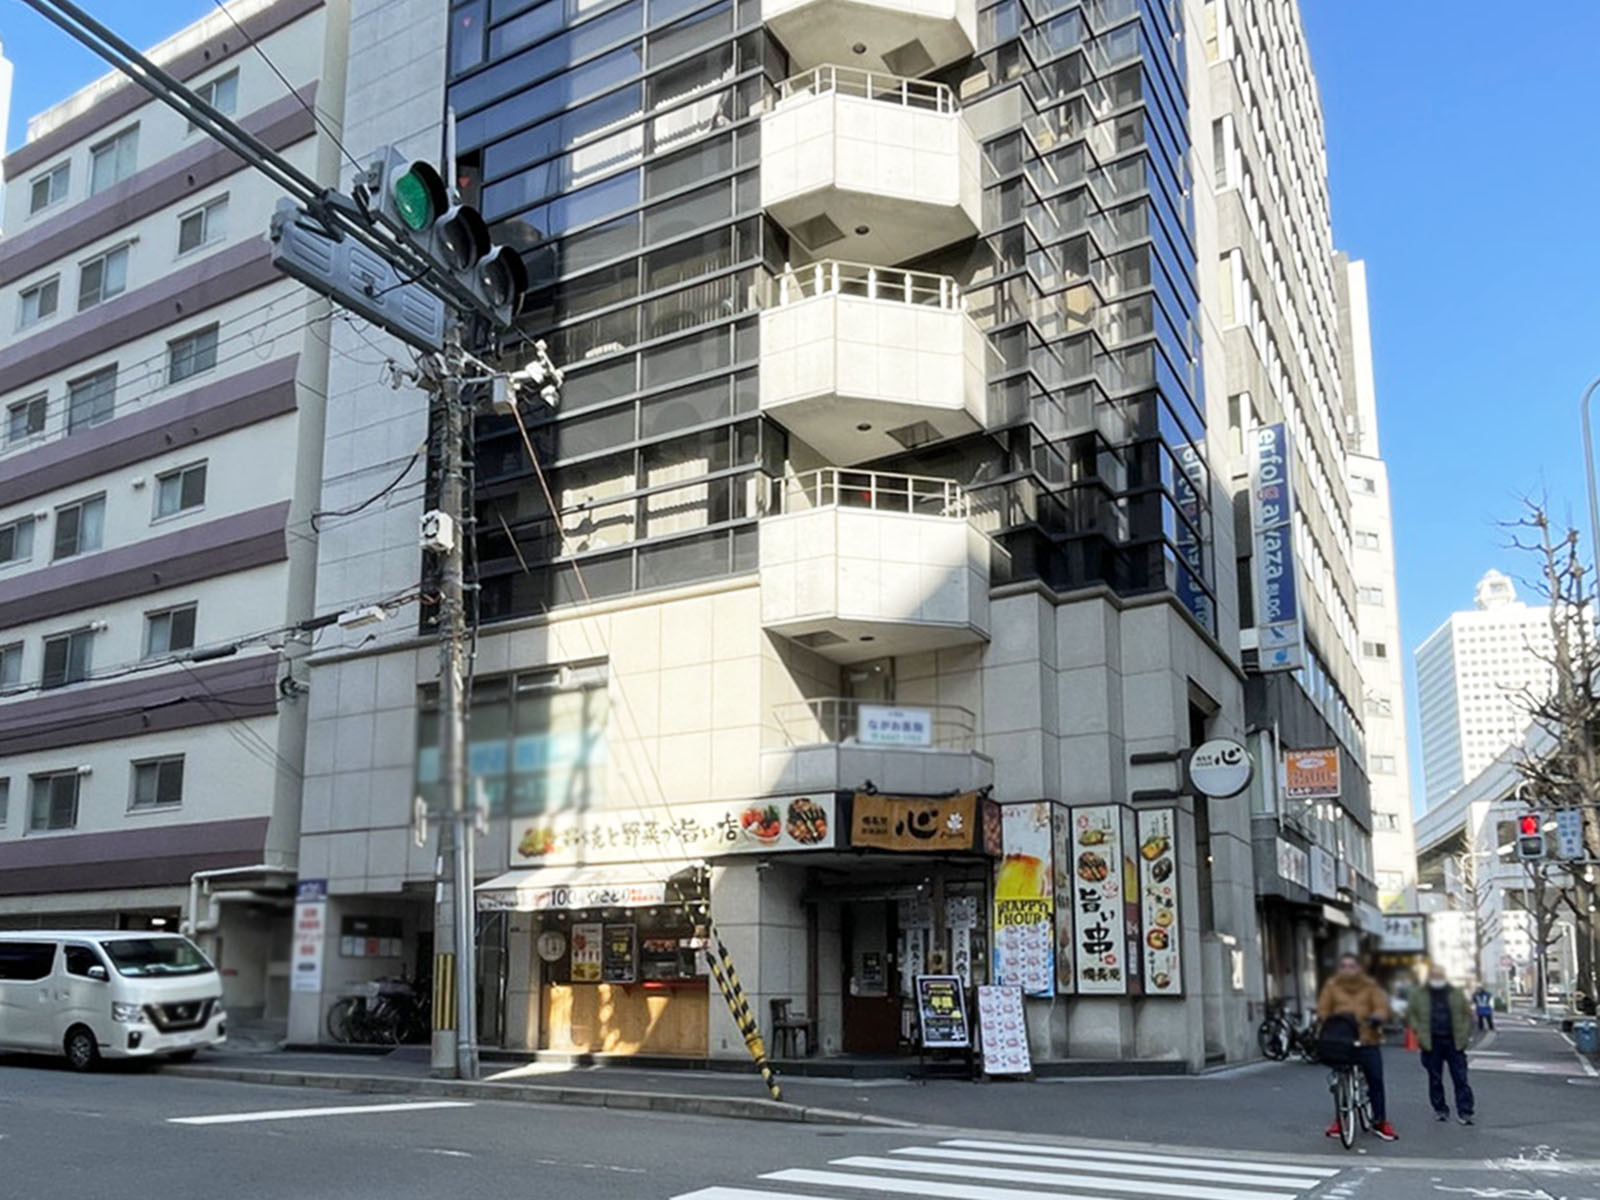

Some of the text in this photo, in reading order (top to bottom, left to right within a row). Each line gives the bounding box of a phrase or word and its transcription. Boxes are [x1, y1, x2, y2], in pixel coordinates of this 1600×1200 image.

[1257, 428, 1284, 501] erfolg
[1214, 747, 1242, 765] 心
[895, 809, 939, 840] 心
[1001, 901, 1049, 913] HAPPY
[1004, 912, 1042, 926] HOUR
